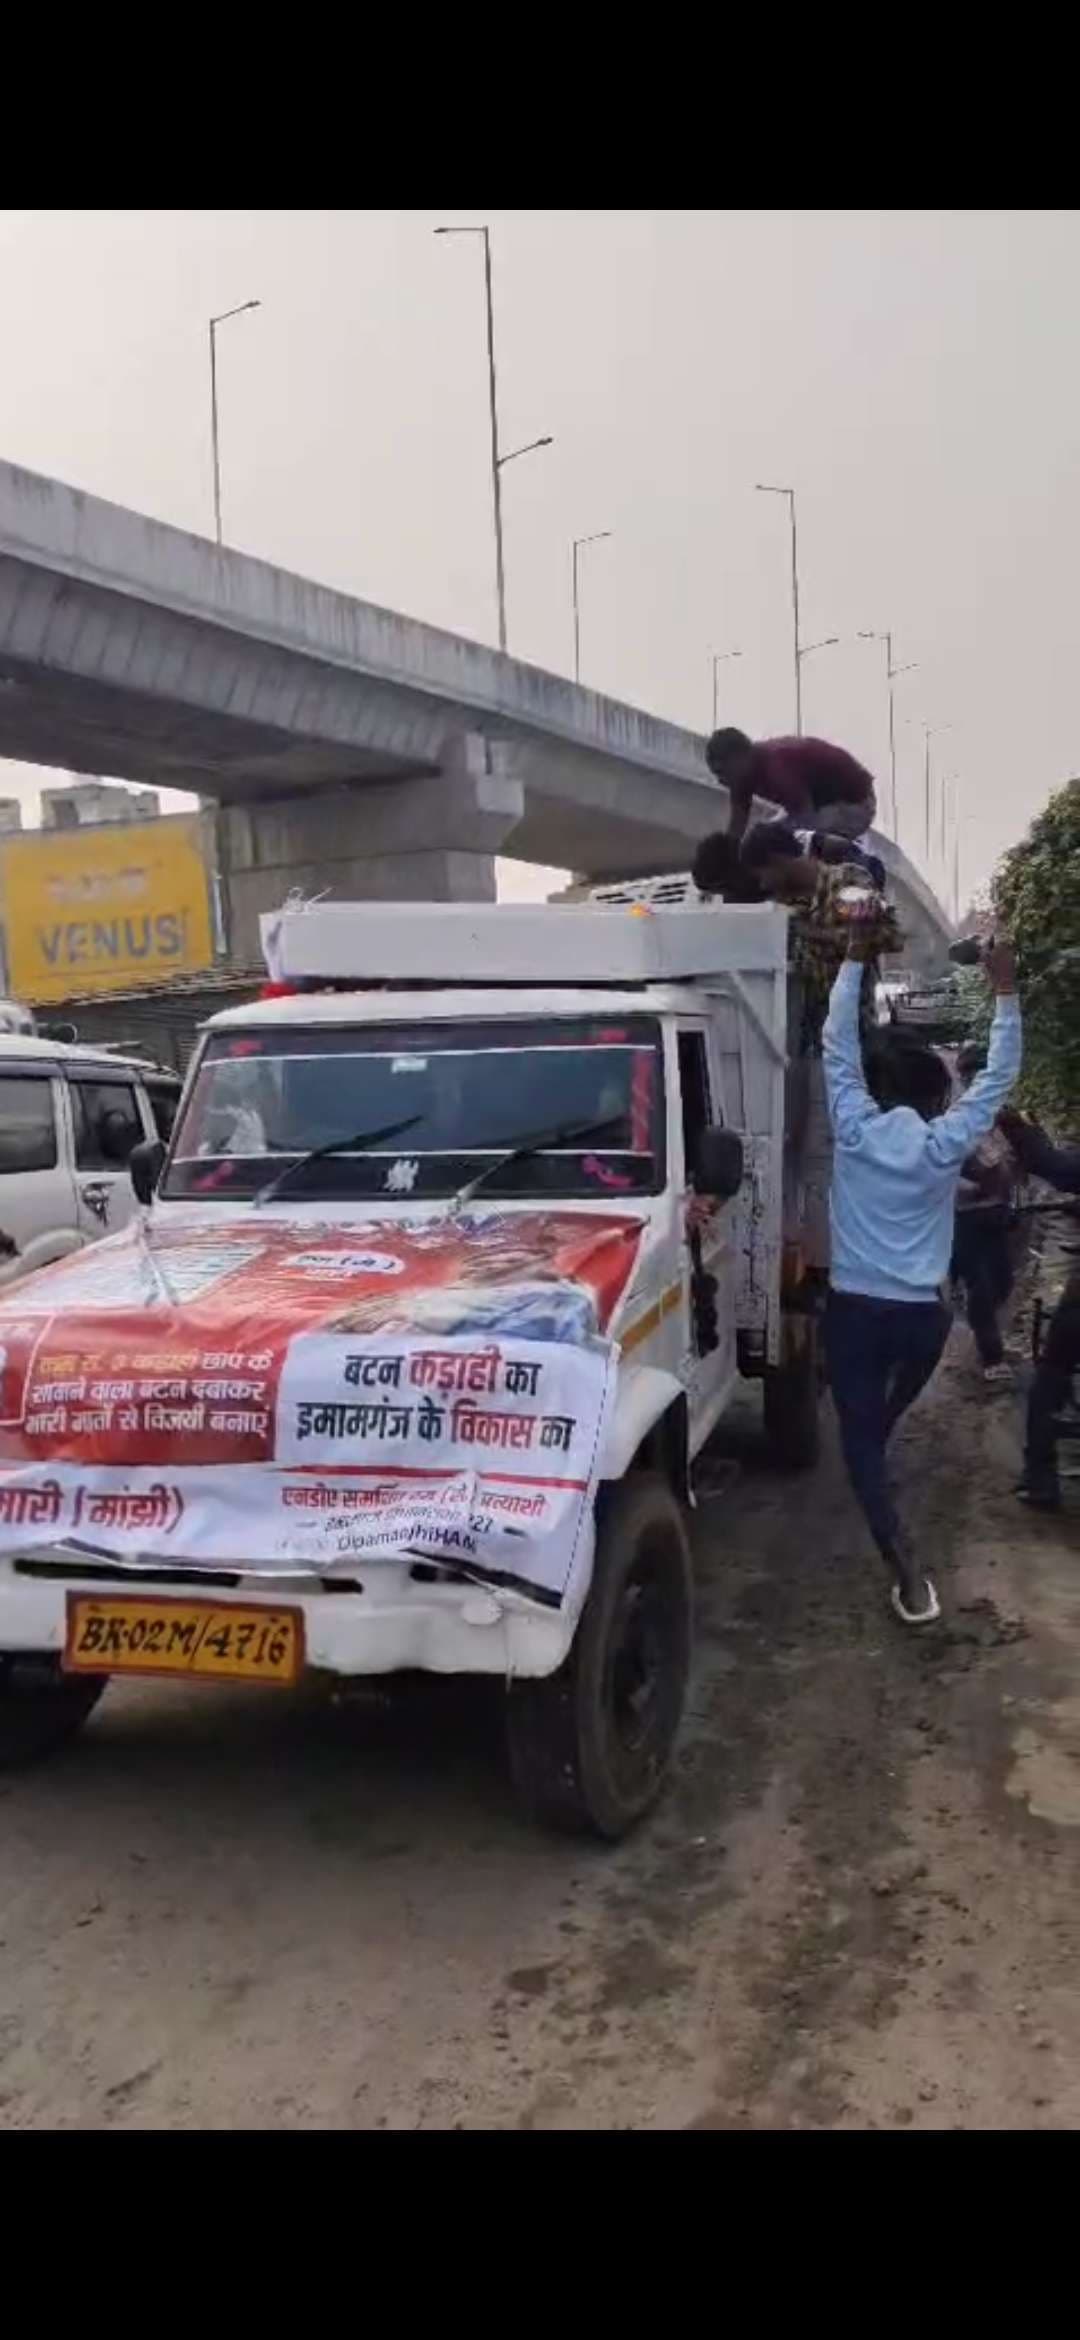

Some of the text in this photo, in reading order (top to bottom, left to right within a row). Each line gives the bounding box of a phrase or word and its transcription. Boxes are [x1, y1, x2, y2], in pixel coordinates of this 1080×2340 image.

[37, 912, 182, 965] VENUS
[247, 1349, 276, 1371] के
[344, 1344, 542, 1399] बटन कड़ाही का
[31, 1376, 266, 1403] सामने वाला बटन दबाकर
[118, 1402, 140, 1431] से
[144, 1402, 205, 1433] विजयी
[210, 1407, 272, 1438] बनाएं
[296, 1395, 577, 1450] इमामगंज के विकास का
[71, 1483, 185, 1535] (मांझी)
[480, 1491, 546, 1519] प्रत्याशी
